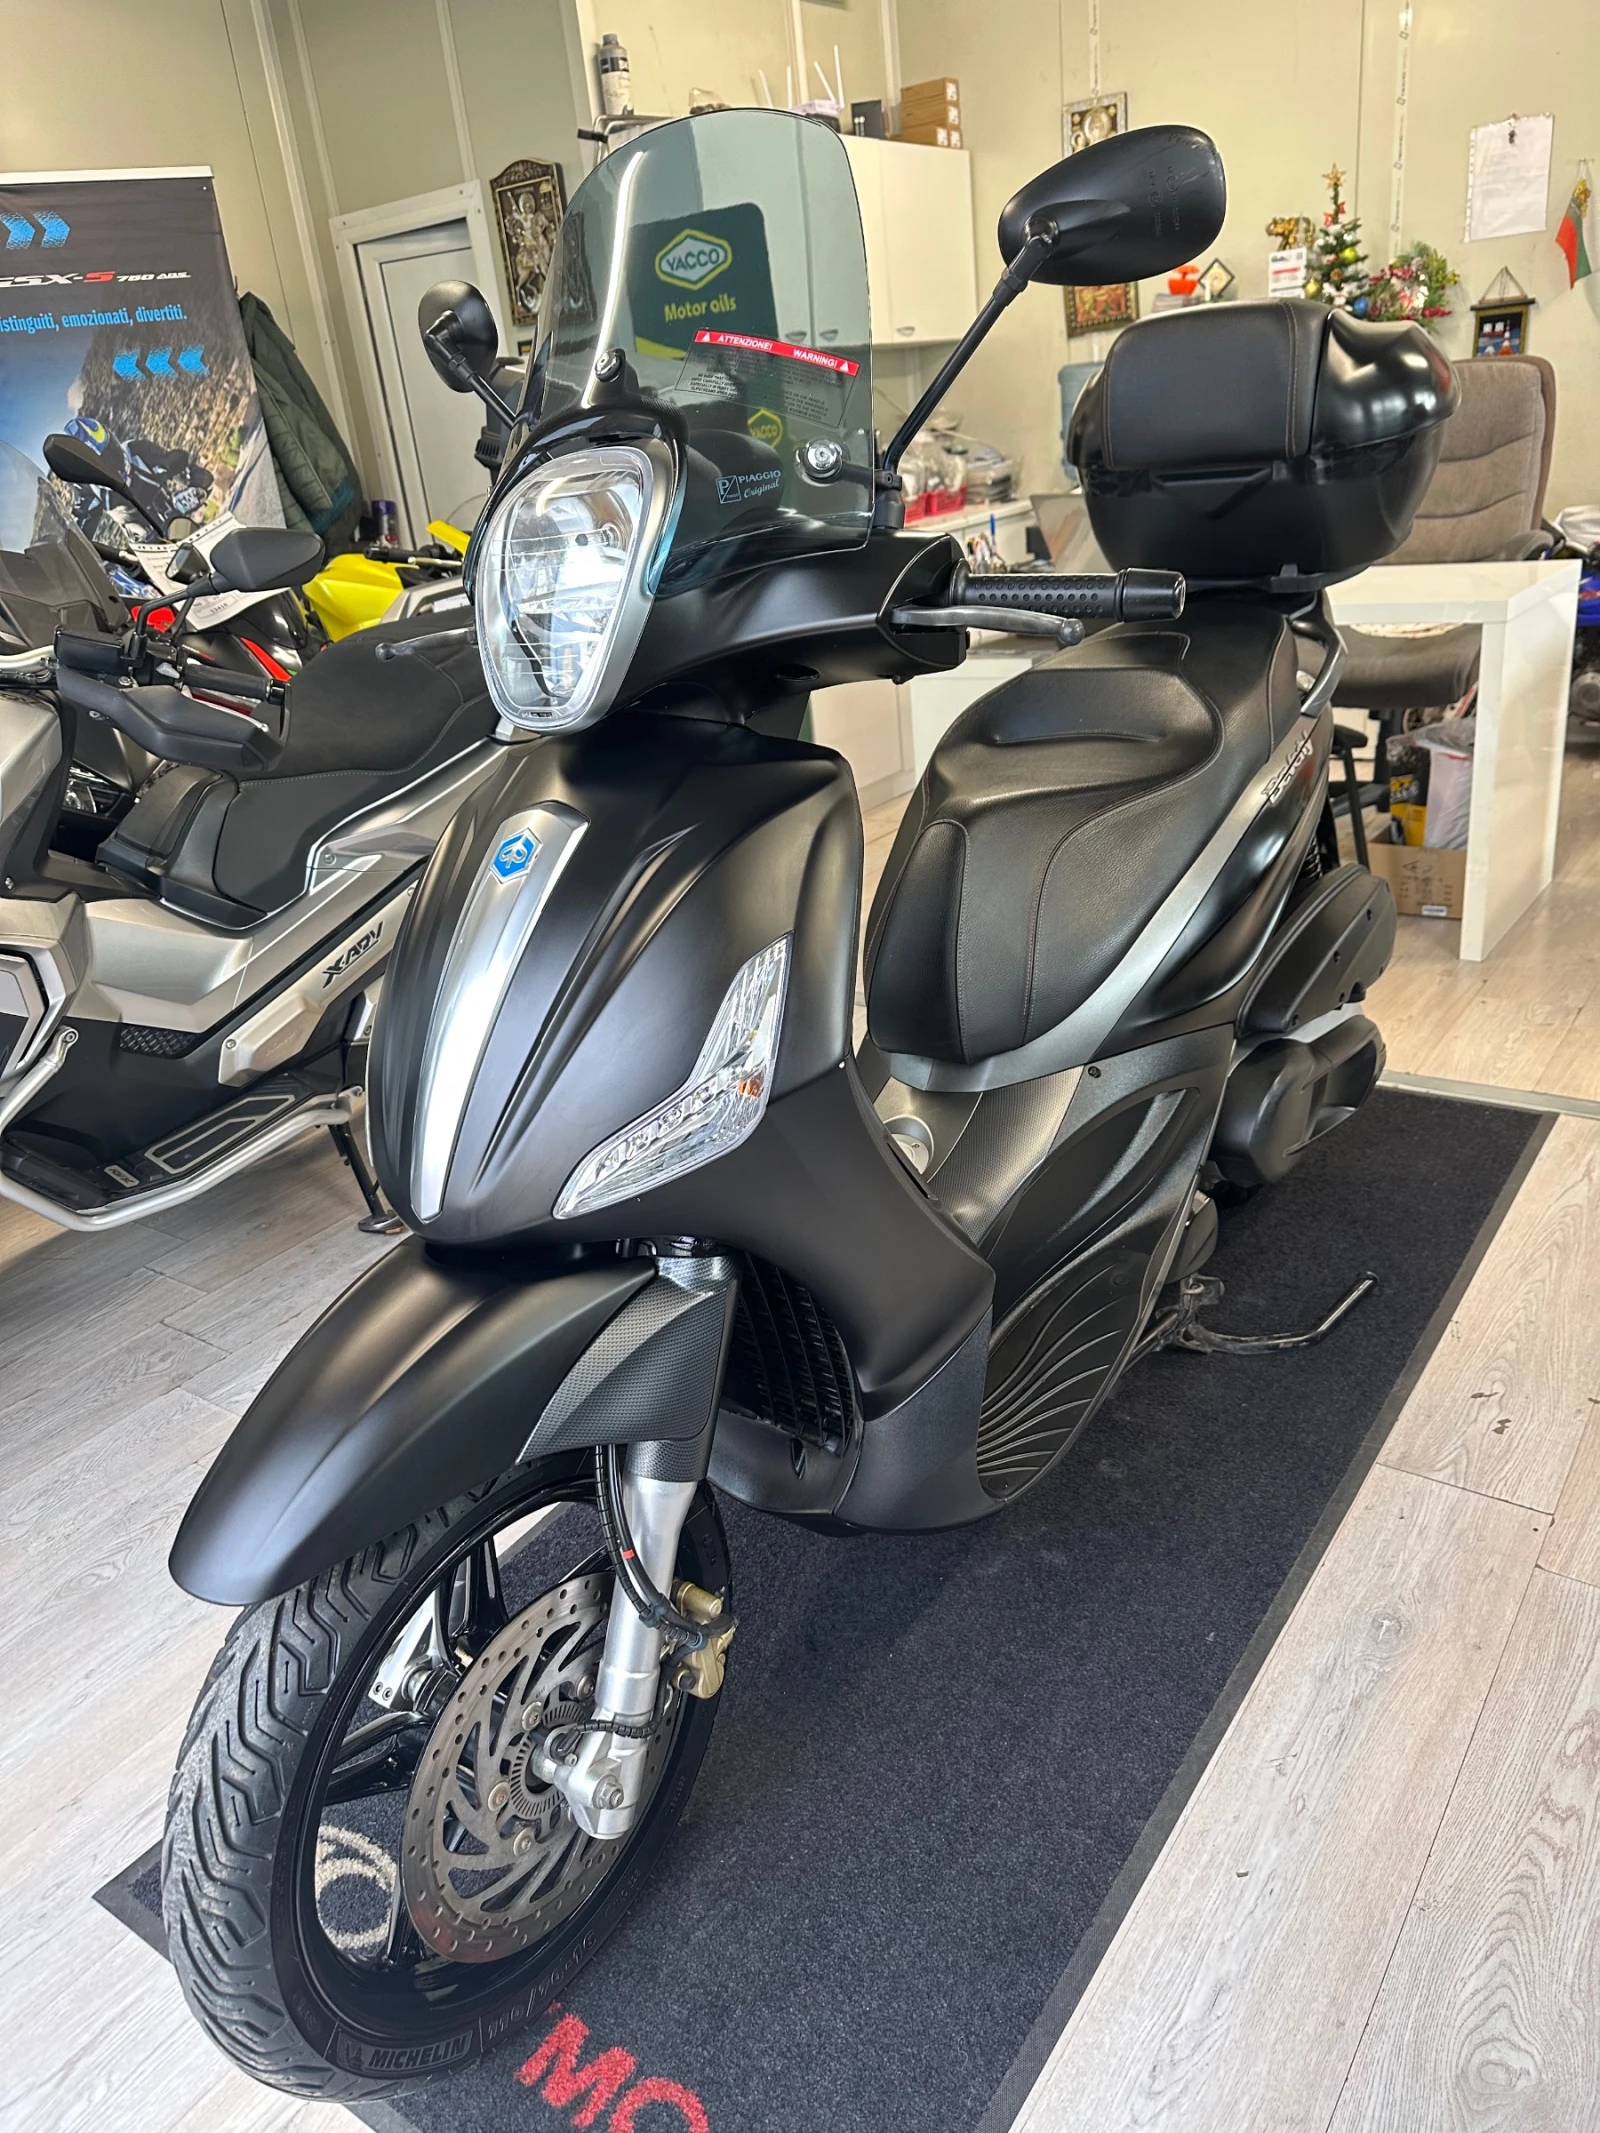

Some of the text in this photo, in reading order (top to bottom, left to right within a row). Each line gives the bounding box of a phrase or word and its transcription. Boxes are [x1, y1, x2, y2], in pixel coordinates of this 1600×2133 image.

[666, 248, 720, 271] YACCO
[116, 273, 155, 282] 750
[61, 308, 133, 327] emozionati,
[135, 304, 188, 323] divertiti.
[664, 293, 737, 322] Motor oils
[717, 334, 773, 350] ATTENZIONE!
[793, 349, 838, 368] WARNING!
[738, 470, 781, 484] PIAGGIO
[744, 478, 780, 498] Original
[368, 2035, 469, 2070] MICHELIN
